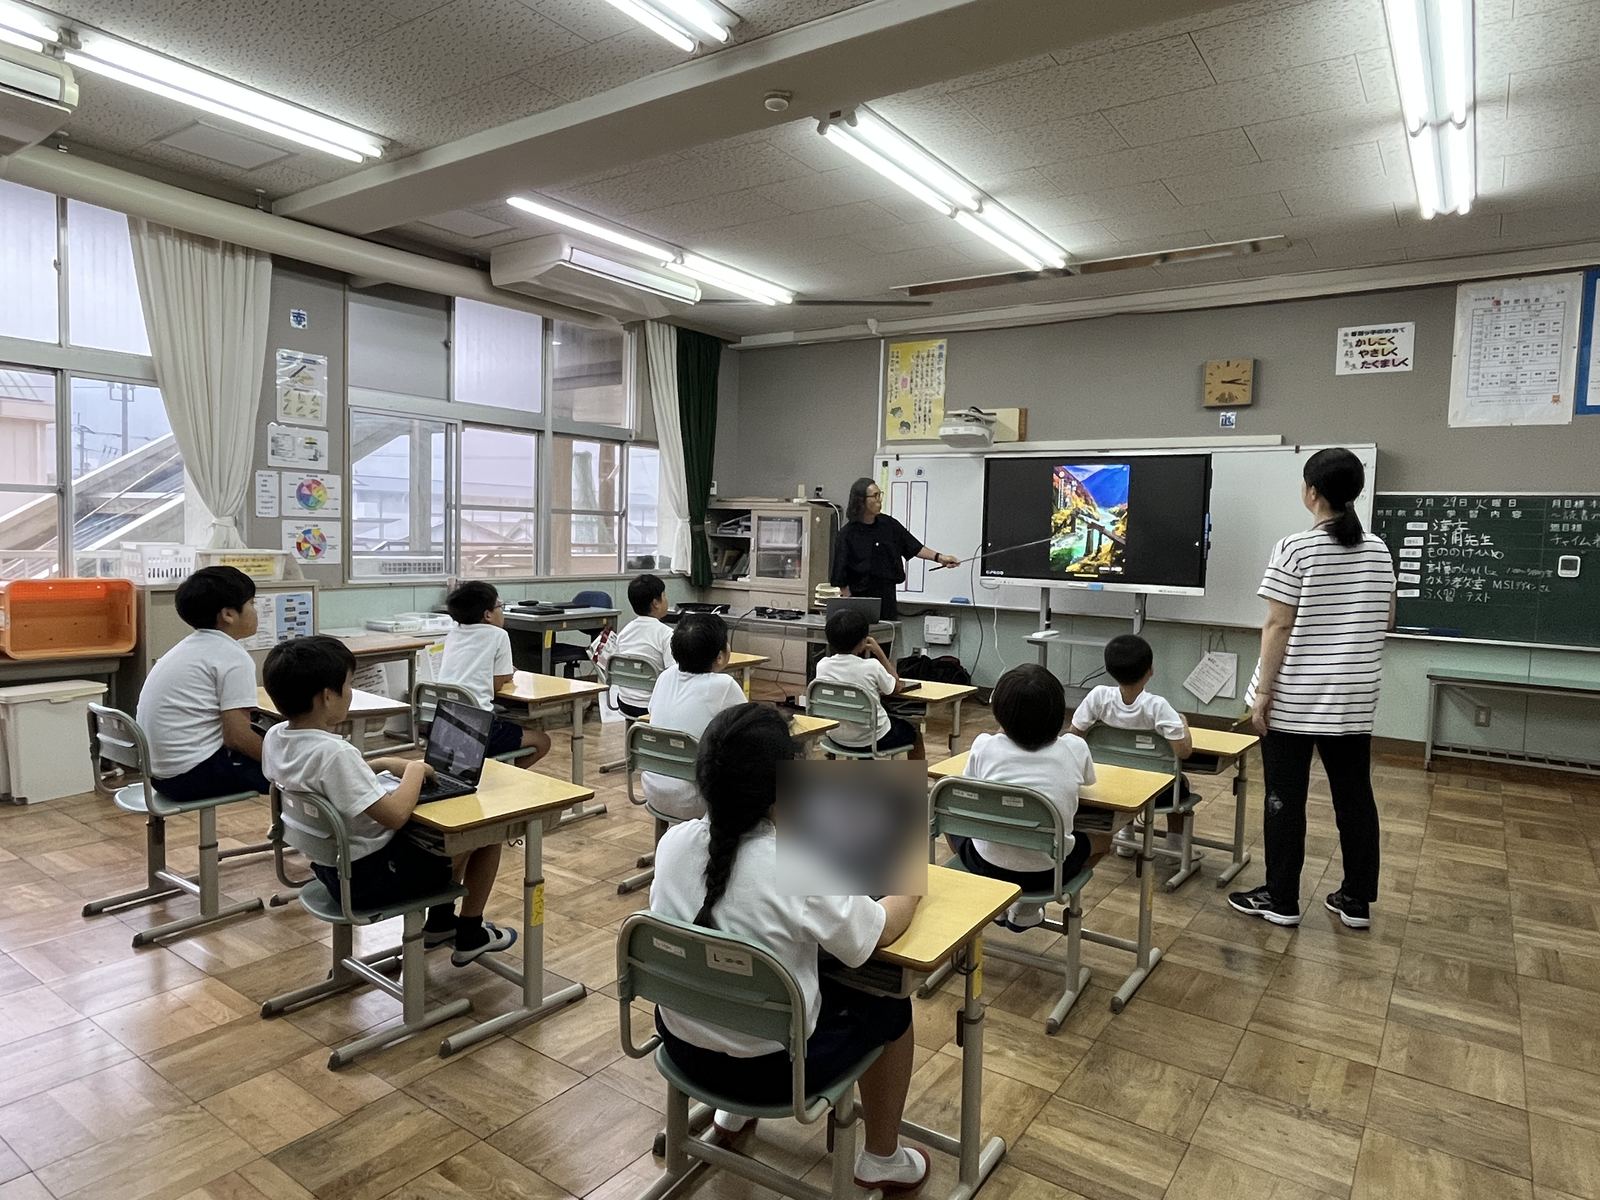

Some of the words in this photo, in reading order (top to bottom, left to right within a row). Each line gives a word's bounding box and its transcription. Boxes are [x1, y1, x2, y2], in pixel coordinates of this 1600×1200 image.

[1355, 336, 1396, 347] かしこく
[1358, 347, 1399, 358] やさしく
[1360, 357, 1409, 369] たくましく
